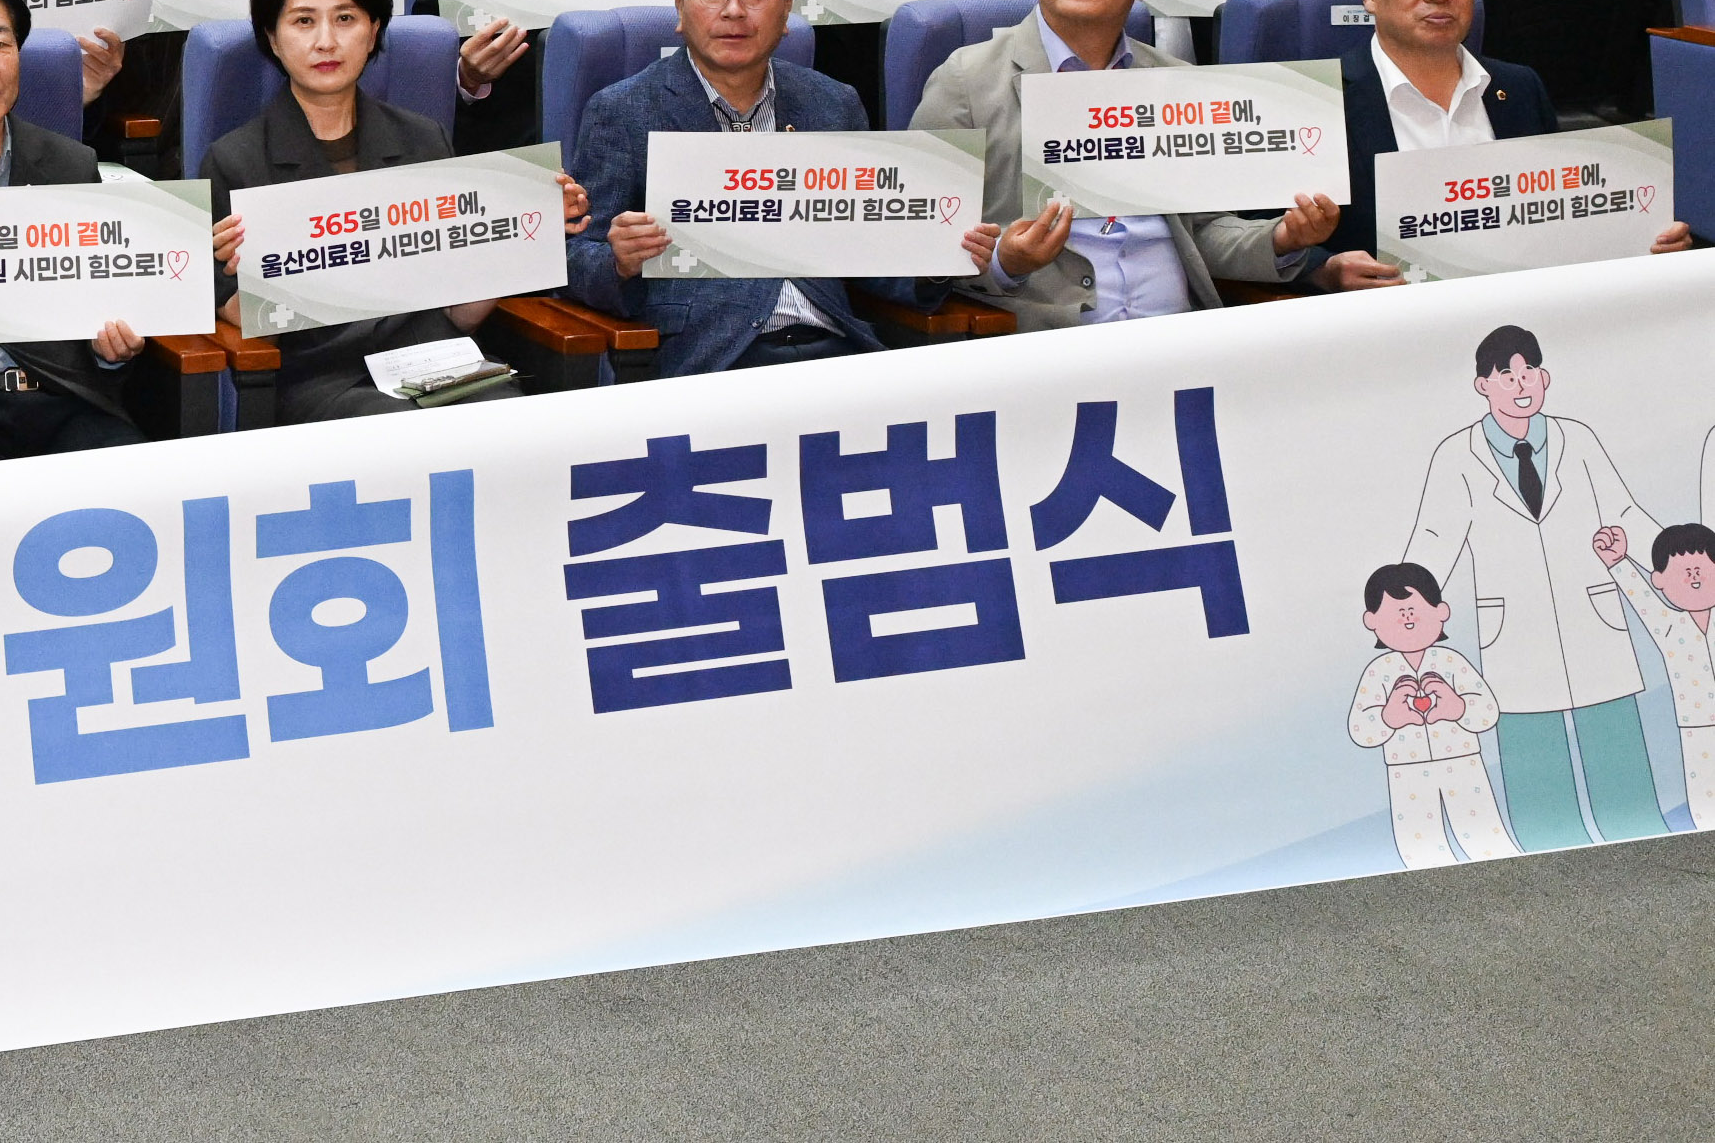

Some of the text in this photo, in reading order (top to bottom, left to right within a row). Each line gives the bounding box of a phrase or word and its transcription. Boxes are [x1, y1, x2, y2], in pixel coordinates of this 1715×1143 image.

[1088, 99, 1261, 129] 365일 아이 곁에,
[1043, 129, 1296, 164] 울산의료원 시민의 힘으로!
[723, 167, 905, 193] 365일 아이 곁에,
[1444, 163, 1606, 203] 365일 아이 곁에,
[309, 191, 486, 239] 365일 아이 곁에,
[670, 198, 936, 223] 울산의료원 시민의 힘으로!
[1398, 189, 1634, 239] 울산의료원 시민의 힘으로!
[26, 223, 70, 248] 아이
[77, 220, 130, 249] 곁에,
[261, 216, 519, 279] 울산의료원 시민의 힘으로!
[14, 255, 81, 282] 시민의
[88, 253, 164, 279] 힘으로!
[563, 386, 1250, 713] 출범식
